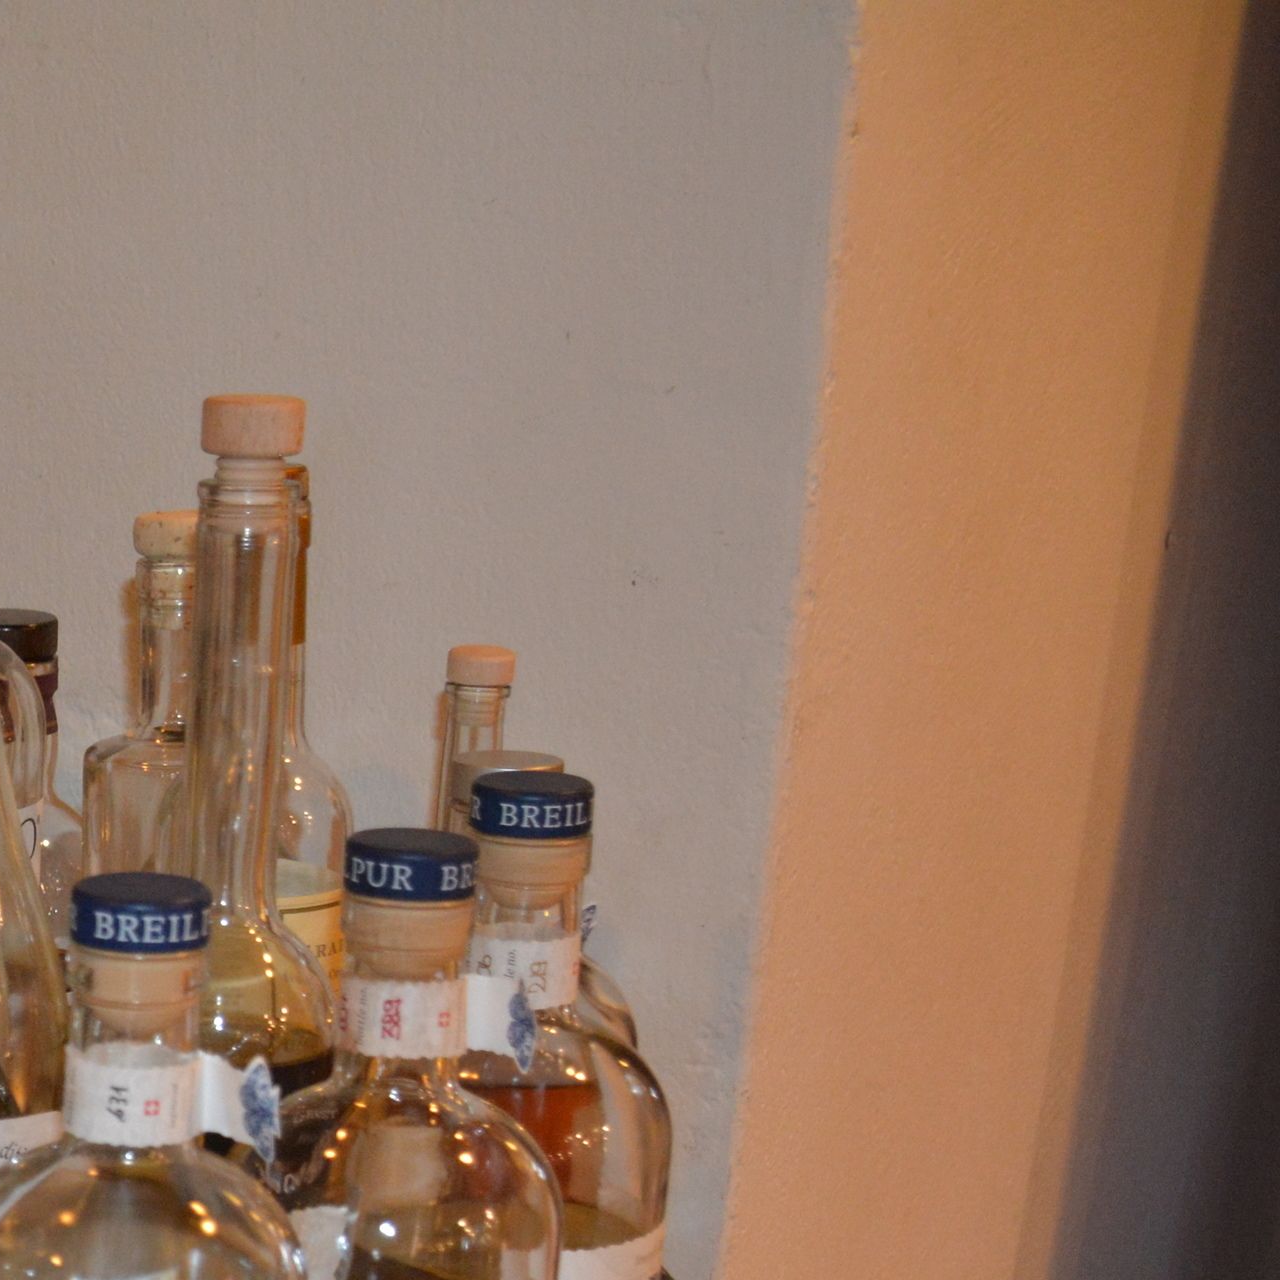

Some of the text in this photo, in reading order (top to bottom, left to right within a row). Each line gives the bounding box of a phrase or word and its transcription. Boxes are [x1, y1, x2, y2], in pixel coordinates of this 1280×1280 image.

[500, 803, 587, 828] BREIL
[351, 857, 414, 891] PUR
[93, 910, 197, 944] BREIL
